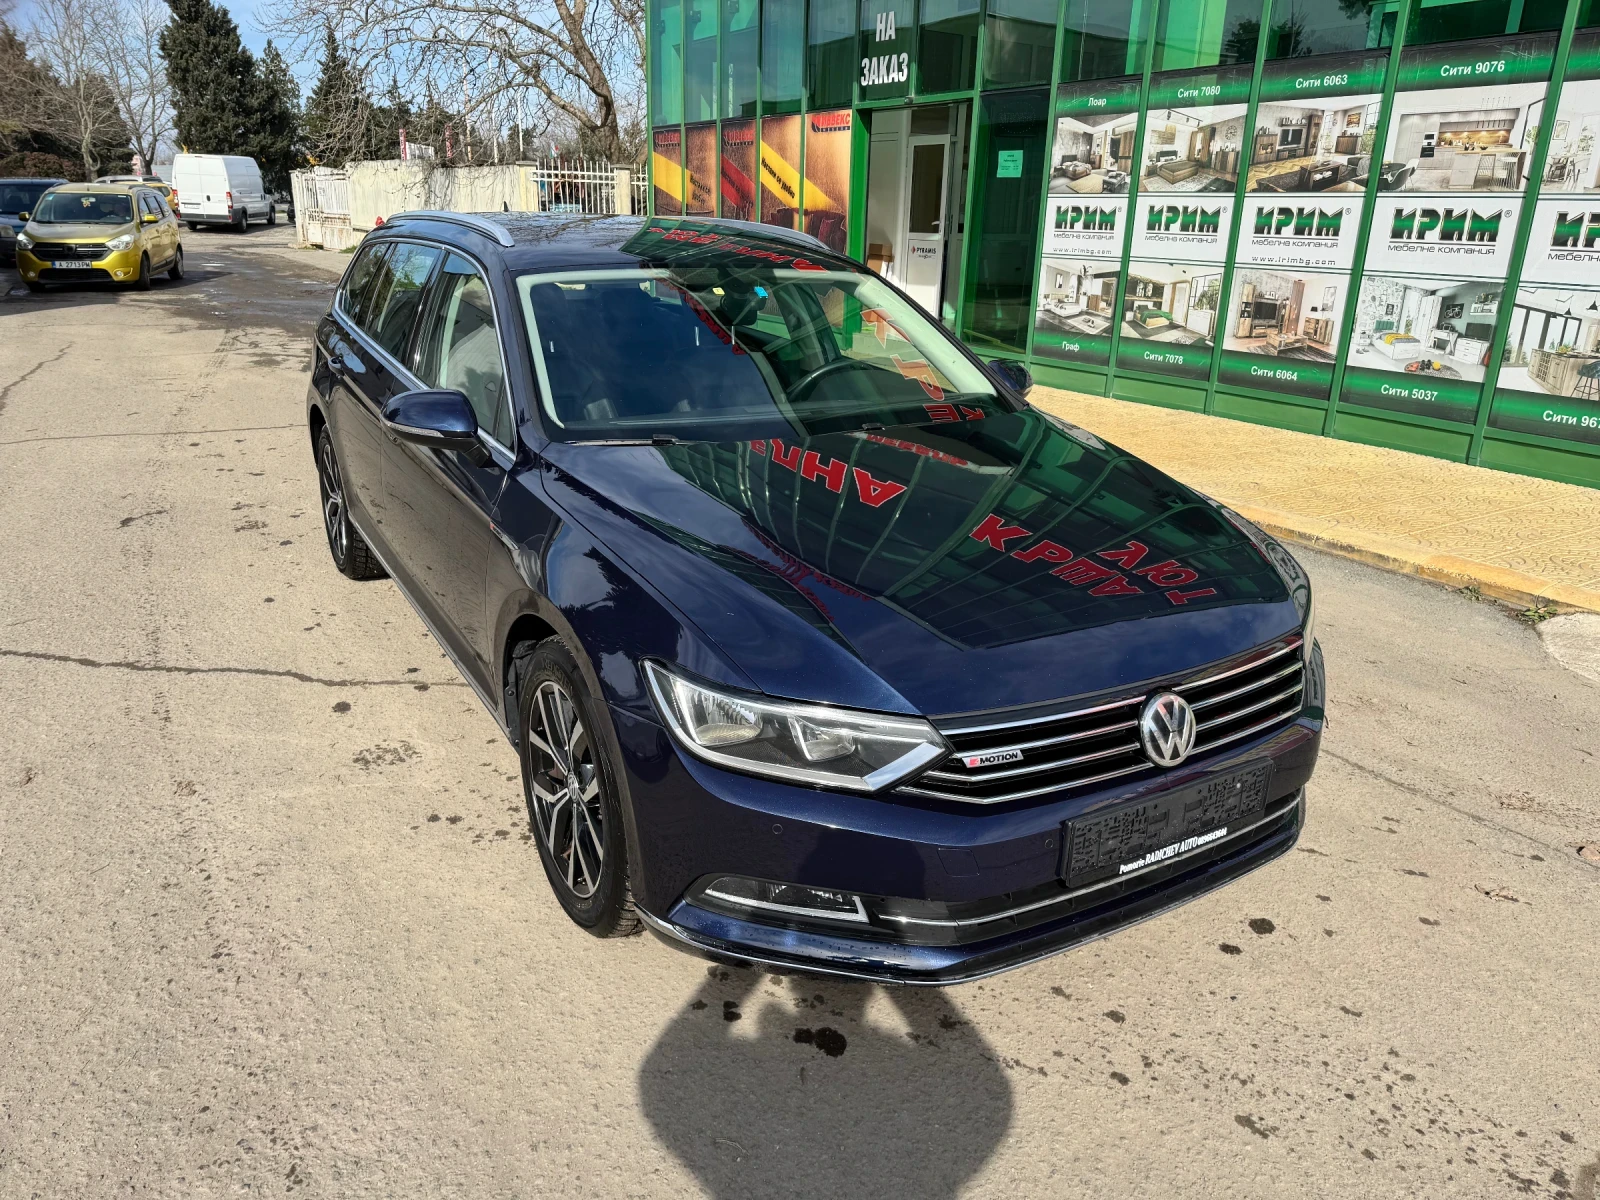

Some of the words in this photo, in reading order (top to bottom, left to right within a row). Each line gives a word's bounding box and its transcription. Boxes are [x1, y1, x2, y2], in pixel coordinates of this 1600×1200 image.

[876, 11, 896, 42] НА
[860, 52, 908, 86] ЗАКАЗ
[1440, 64, 1472, 77] Сити
[1475, 61, 1505, 74] 9076
[1295, 78, 1321, 89] Сити
[1323, 74, 1348, 86] 6063
[1177, 88, 1198, 98] Сити
[1200, 85, 1221, 97] 7080
[1088, 97, 1107, 107] Лоар
[1055, 205, 1117, 231] ИРИМ
[1146, 204, 1221, 233] ИРИМ
[1253, 206, 1344, 237] ИРИМ
[1389, 207, 1503, 242] ИРИМ
[1145, 235, 1178, 243] мебелна
[1179, 236, 1218, 244] компания
[1251, 239, 1291, 247] мебелна
[1292, 240, 1339, 249] компания
[916, 247, 937, 255] PYRAMIS
[1388, 243, 1435, 253] мебелна
[1438, 246, 1496, 255] компания
[1251, 256, 1336, 266] www.irimbg.com
[1547, 252, 1600, 262] мебелн
[1062, 341, 1080, 353] Граф
[1144, 351, 1163, 363] Сити
[1165, 353, 1183, 365] 7078
[1251, 366, 1274, 379] Сити
[1275, 368, 1298, 381] 6064
[1380, 384, 1409, 398] Сити
[1411, 387, 1438, 402] 5037
[1542, 410, 1578, 425] Сити
[1119, 858, 1146, 874] Pomorie
[1145, 842, 1180, 865] RADICHEV
[1180, 836, 1198, 852] AUTO
